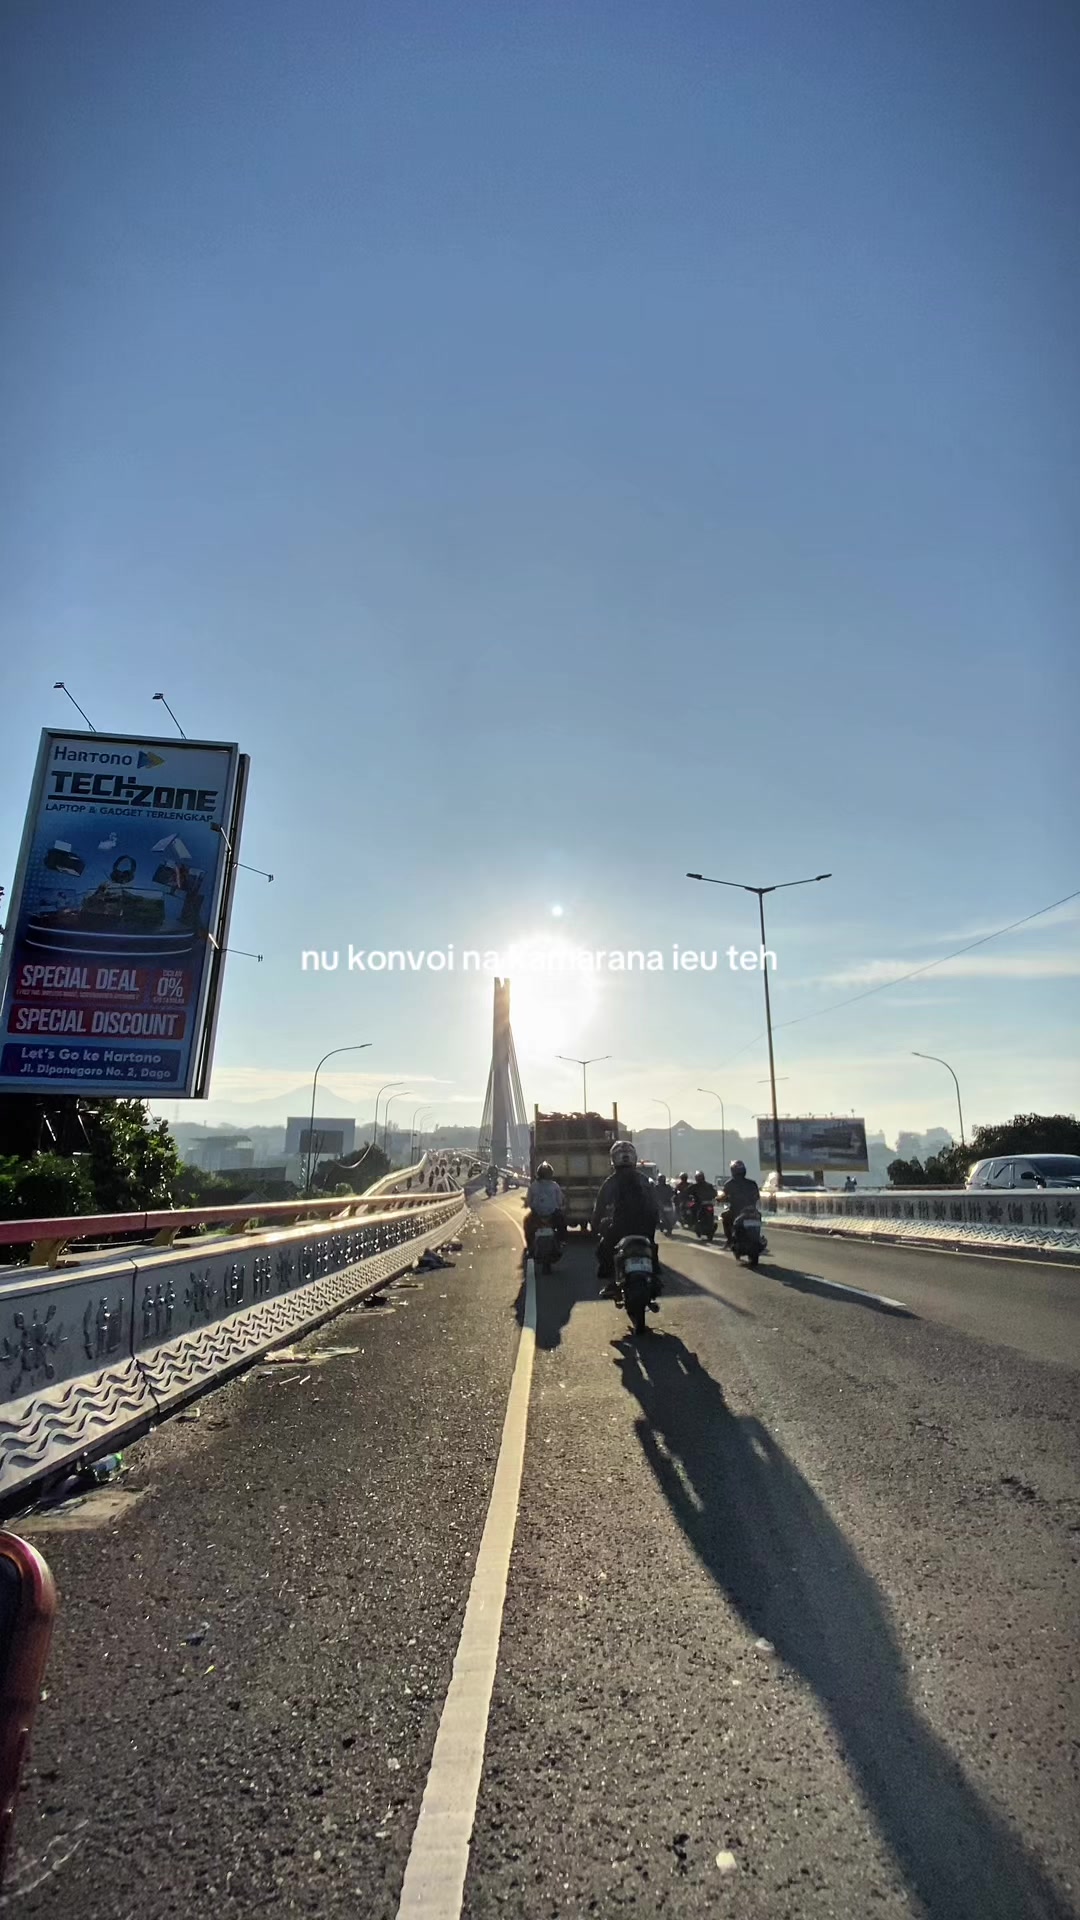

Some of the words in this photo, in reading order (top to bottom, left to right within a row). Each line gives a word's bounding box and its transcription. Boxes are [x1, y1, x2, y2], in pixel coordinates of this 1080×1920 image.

[45, 803, 86, 813] LAPTOP
[88, 806, 96, 814] &
[99, 806, 143, 817] GADGET
[146, 810, 214, 823] TERLENGKAP
[21, 964, 91, 989] SPECIAL
[95, 967, 140, 992] DEAL
[157, 977, 184, 997] 0%
[15, 1007, 87, 1033] SPECIAL
[91, 1011, 180, 1036] DISCOUNT
[21, 1047, 55, 1060] Let's
[59, 1048, 79, 1061] Go
[83, 1049, 100, 1062] ke
[104, 1051, 162, 1064] Hartono
[37, 1063, 103, 1077] Diponegoro
[106, 1066, 124, 1077] No.
[140, 1068, 171, 1080] Dago
